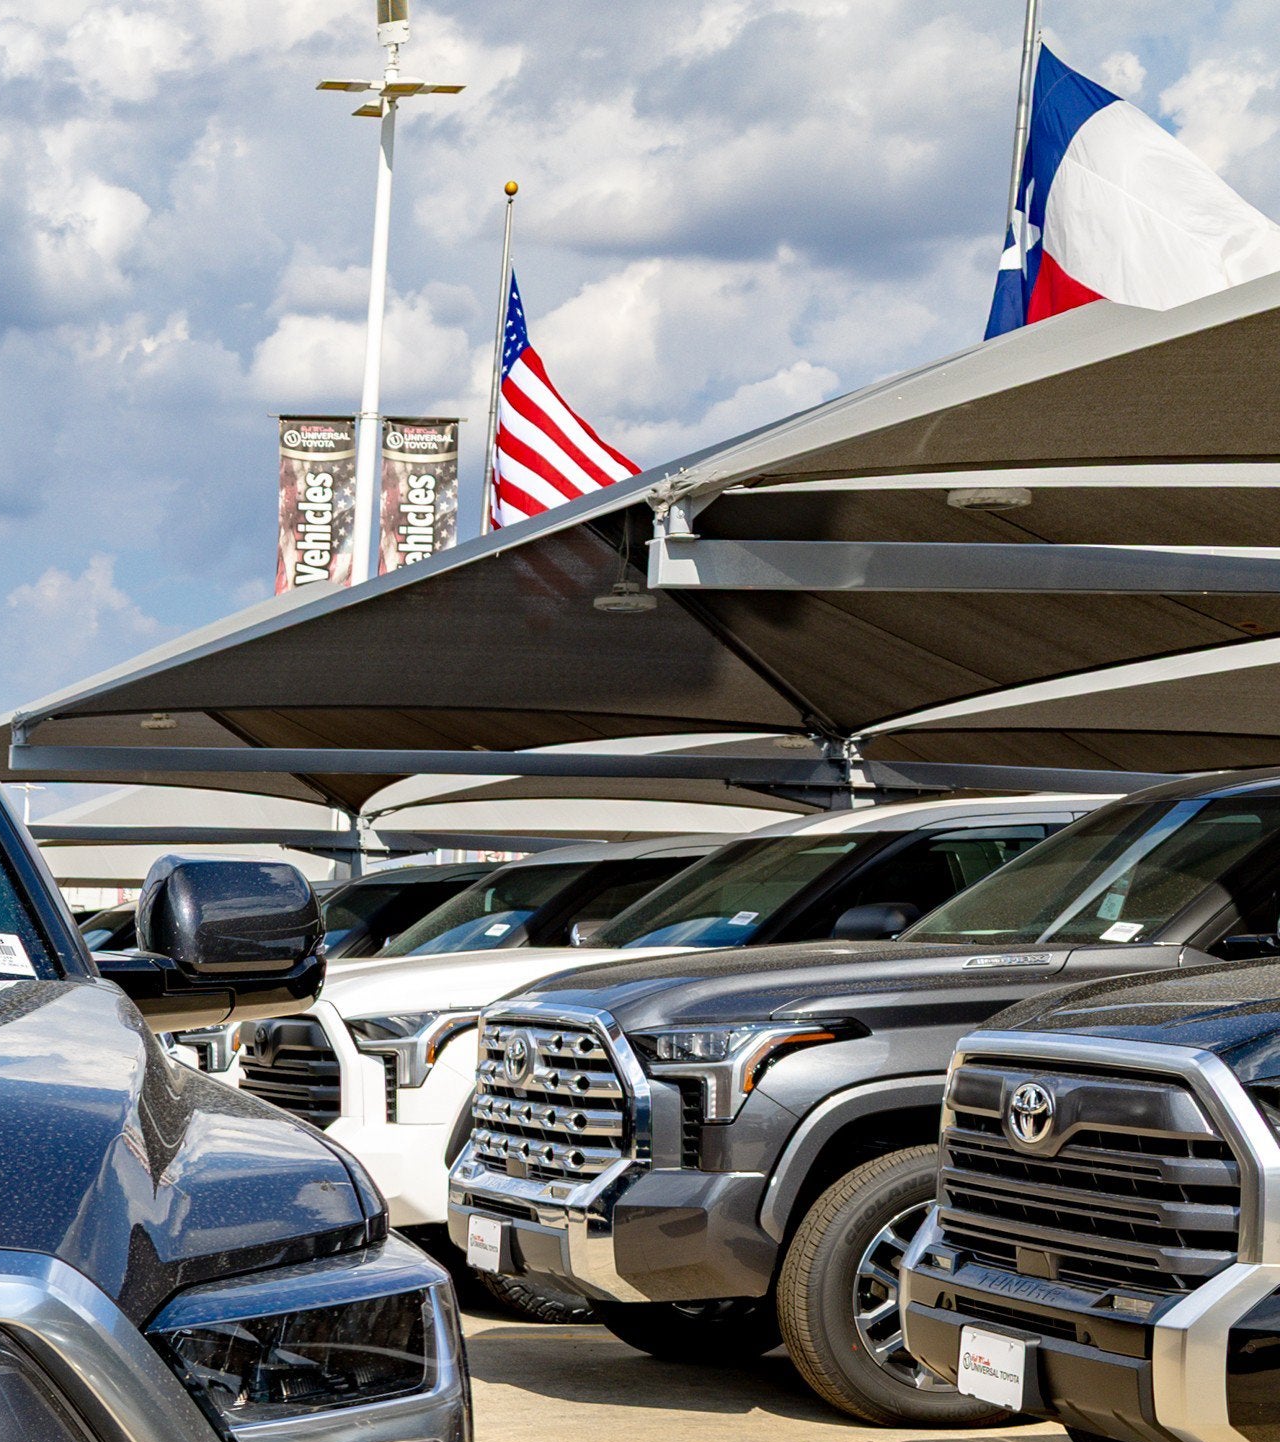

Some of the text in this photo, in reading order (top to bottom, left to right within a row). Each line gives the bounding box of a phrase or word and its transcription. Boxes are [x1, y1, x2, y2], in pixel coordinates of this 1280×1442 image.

[301, 432, 351, 440] UNIVERSAL
[403, 433, 454, 442] UNIVERSAL
[301, 440, 336, 448] TOYOTA
[404, 441, 438, 450] TOYOTA
[398, 474, 435, 569] ehicles
[295, 472, 333, 586] Vehicles
[971, 1362, 1020, 1384] UNIVERSAL TOYOTA
